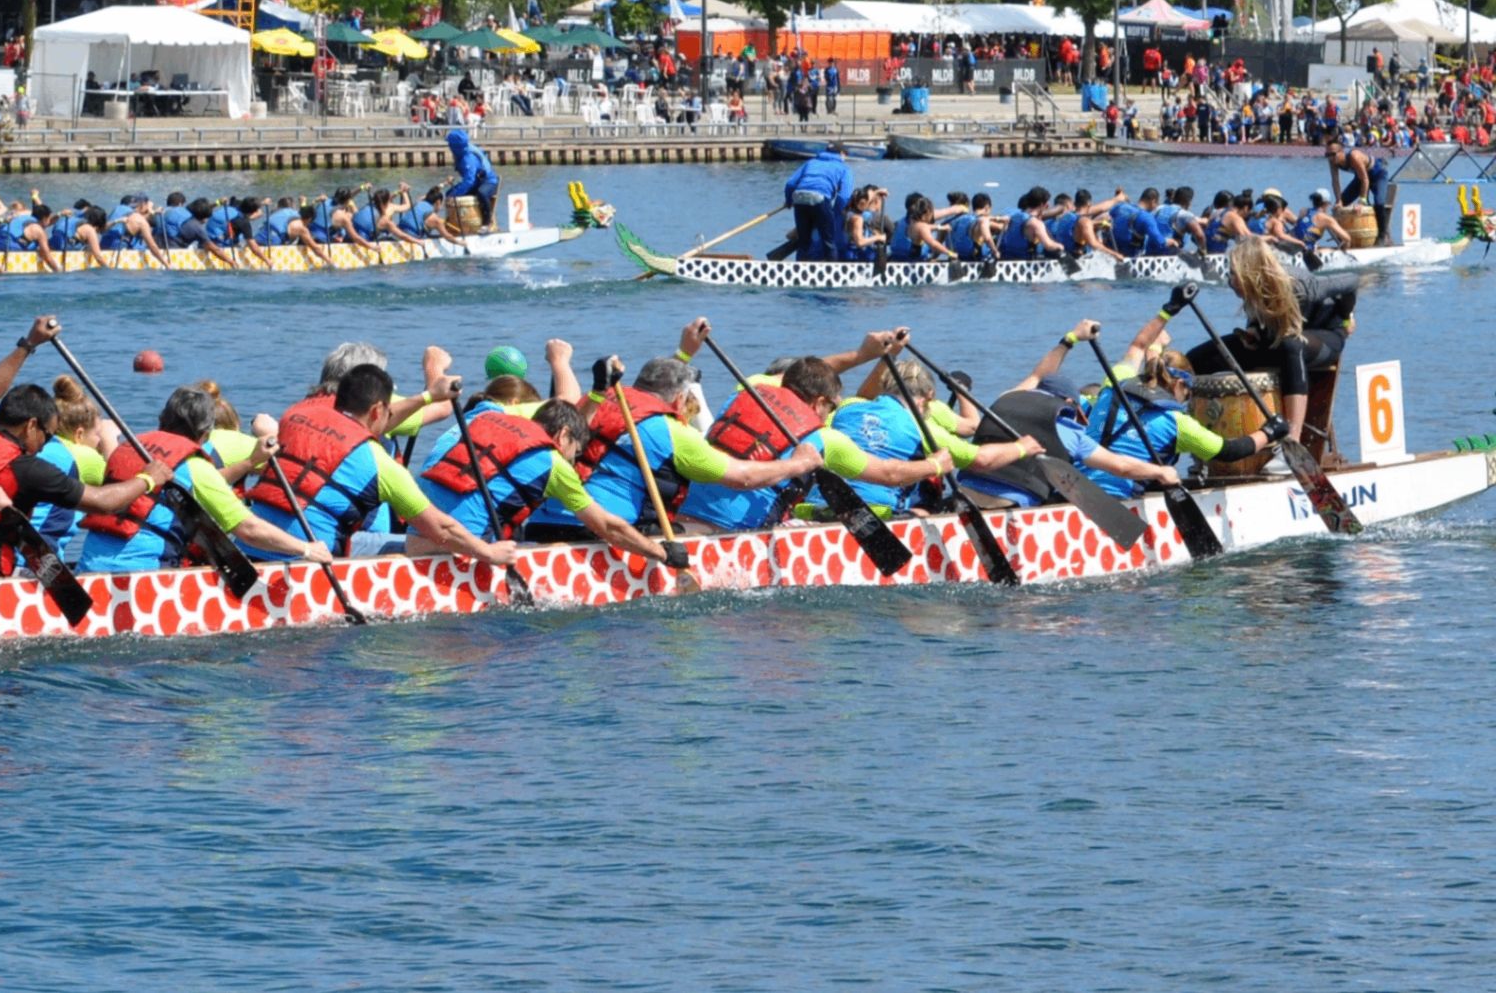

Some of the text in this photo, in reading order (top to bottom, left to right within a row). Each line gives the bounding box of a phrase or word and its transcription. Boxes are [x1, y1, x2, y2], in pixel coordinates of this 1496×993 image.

[513, 198, 524, 224] 2
[1406, 209, 1417, 237] 3
[1367, 374, 1394, 444] 6
